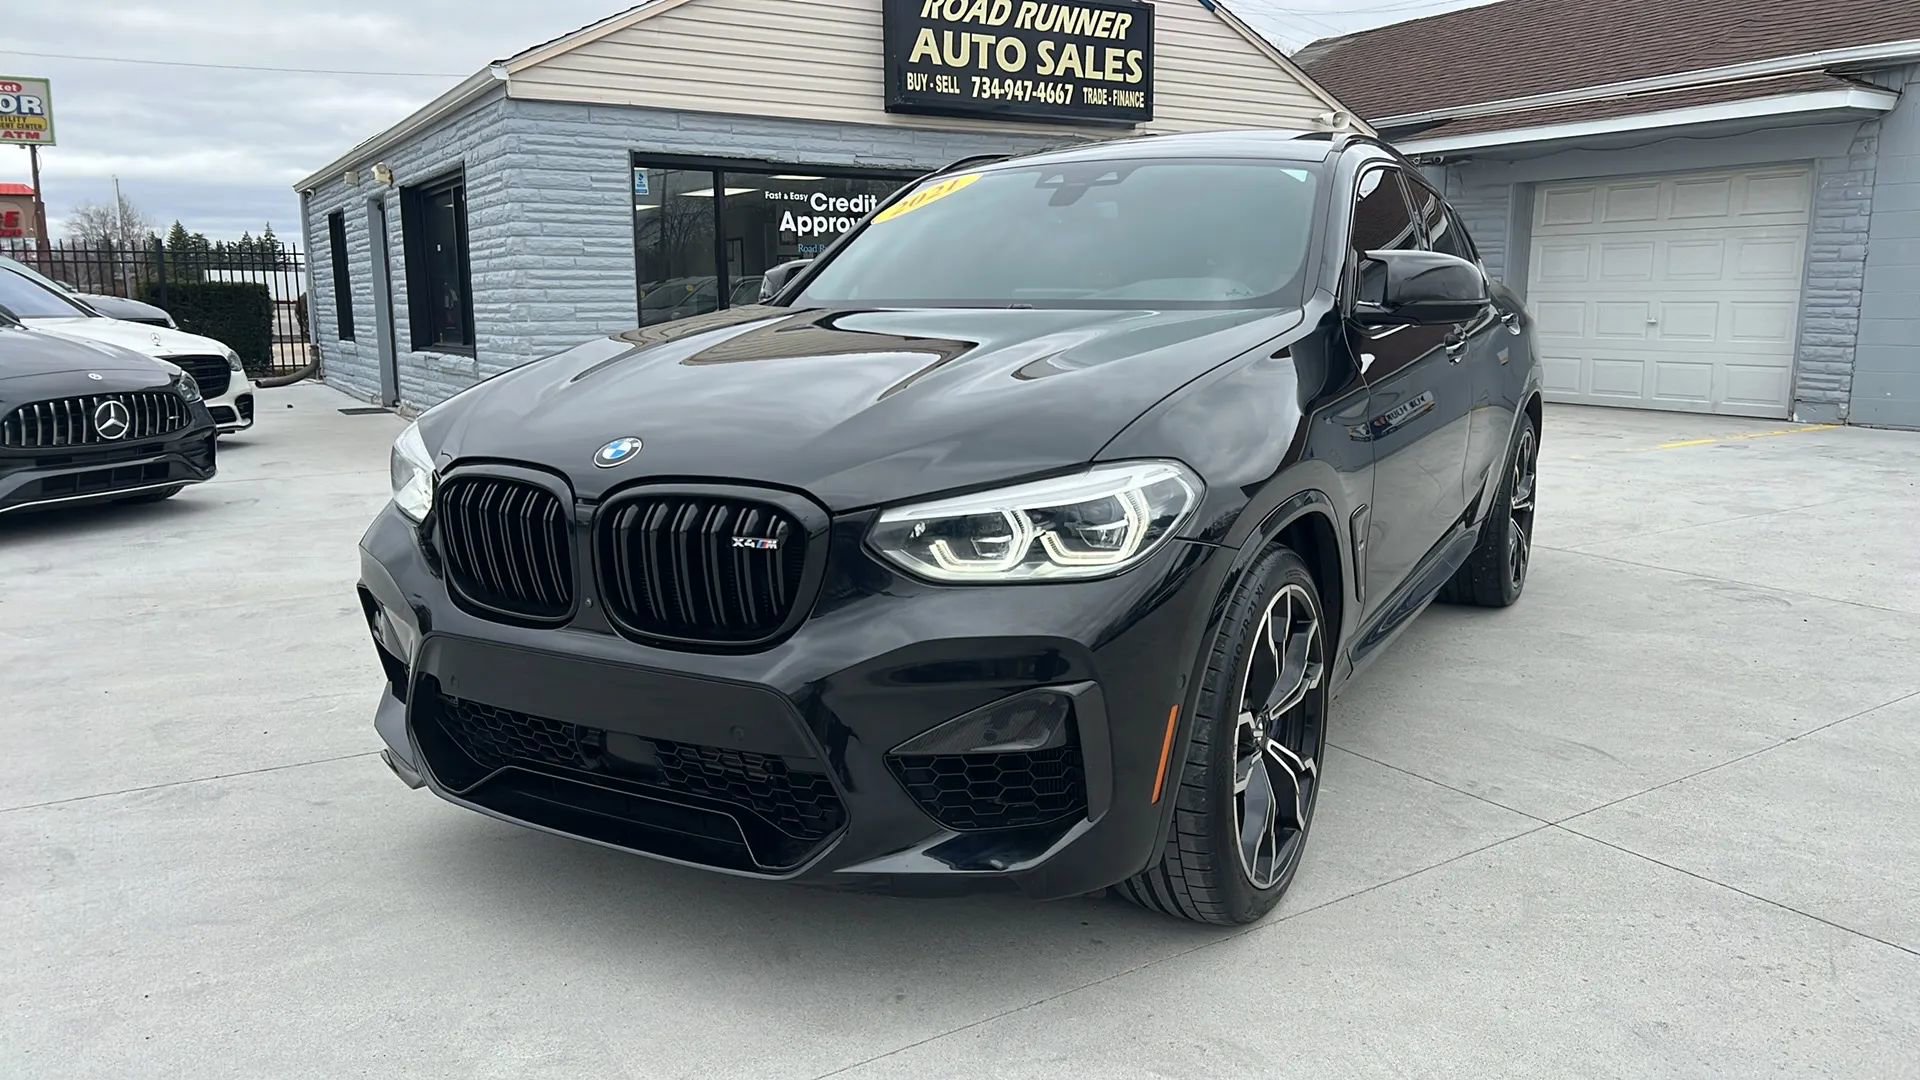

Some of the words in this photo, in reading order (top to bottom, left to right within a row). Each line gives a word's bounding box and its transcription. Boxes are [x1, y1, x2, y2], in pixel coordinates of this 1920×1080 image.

[920, 0, 1012, 26] ROAD
[1014, 1, 1132, 40] RUNNER
[908, 27, 1027, 73] AUTO
[1036, 40, 1143, 84] SALES
[906, 72, 928, 92] BUY
[935, 74, 960, 94] SELL
[971, 76, 1074, 105] 734-947-4667
[1082, 87, 1108, 105] TRADE
[1112, 89, 1145, 108] FINANCE
[2, 131, 40, 139] ATM
[764, 191, 782, 200] Fast
[789, 192, 808, 202] Easy
[810, 192, 878, 213] Credit
[888, 179, 959, 217] 2021
[798, 243, 818, 253] Road
